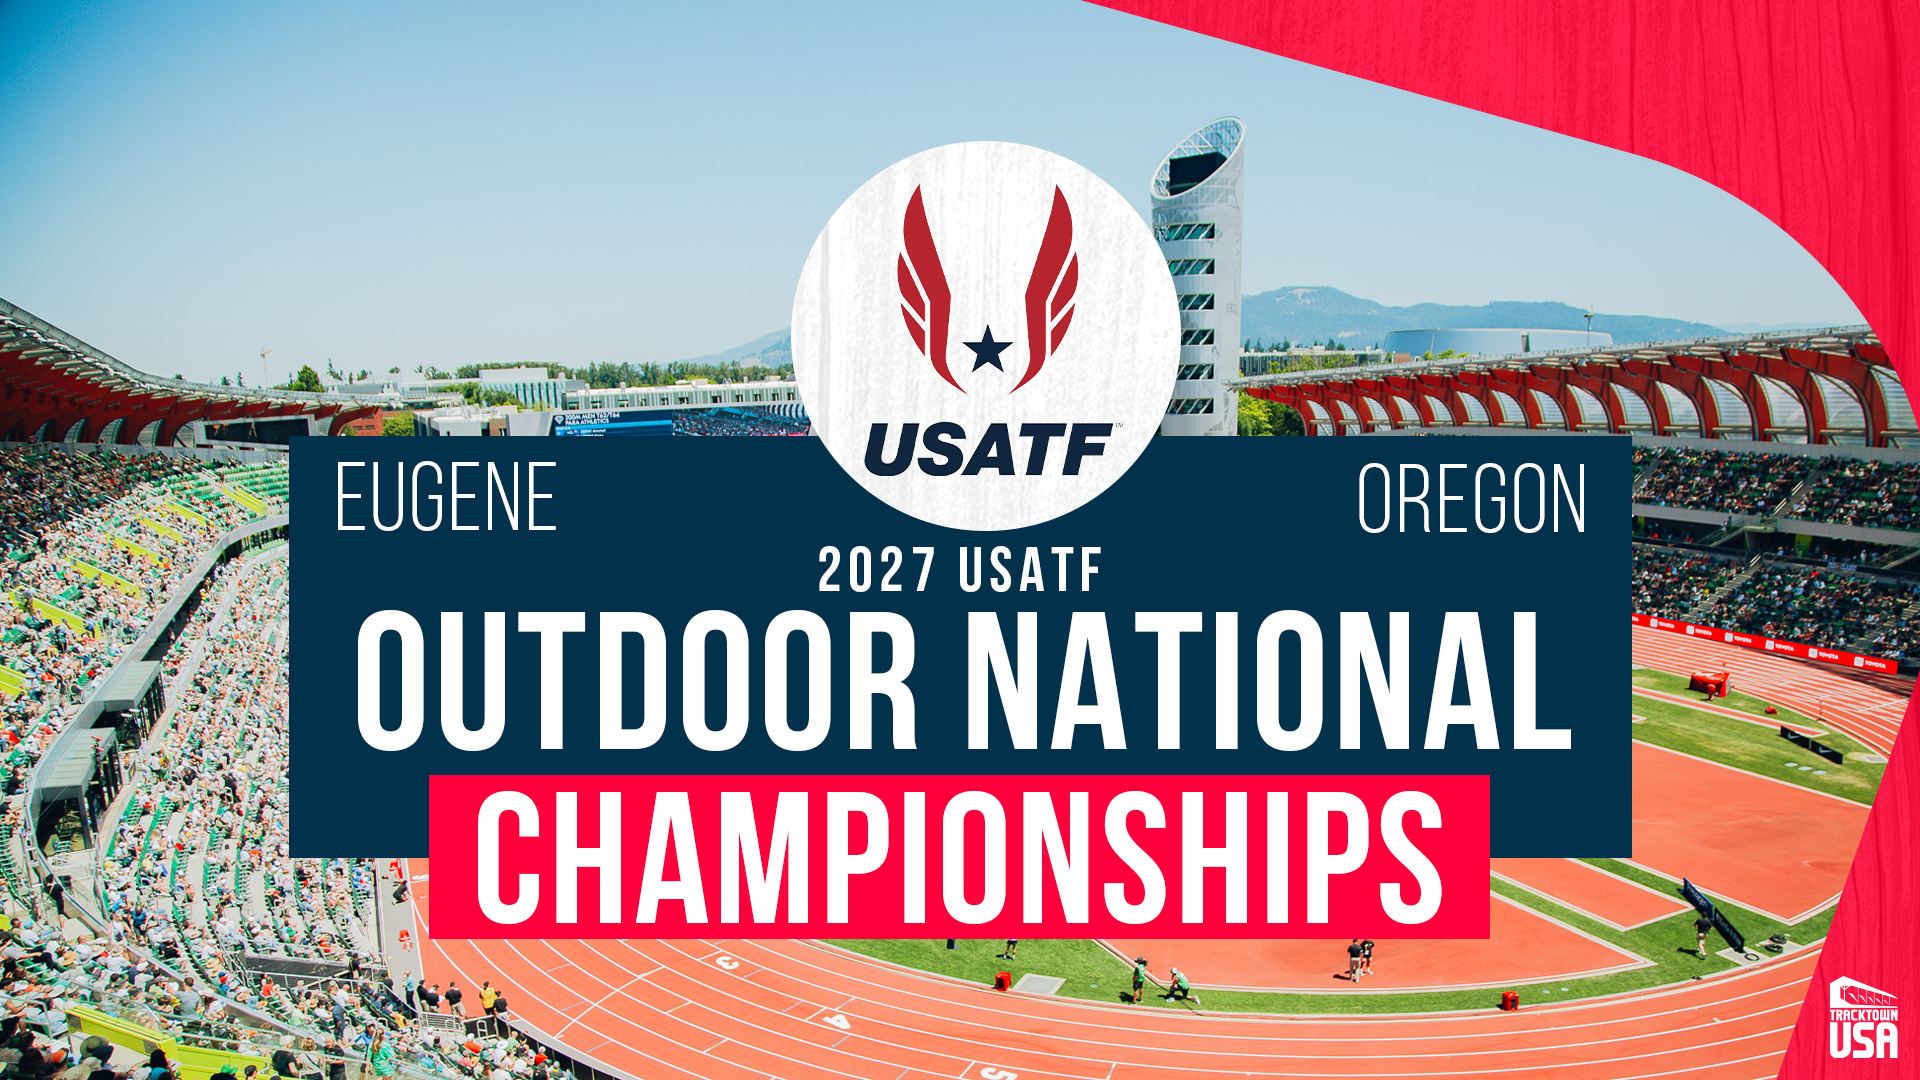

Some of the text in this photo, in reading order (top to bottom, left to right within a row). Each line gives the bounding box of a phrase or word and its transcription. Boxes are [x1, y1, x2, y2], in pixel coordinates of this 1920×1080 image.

[1695, 628, 1712, 636] TOYOTA
[1734, 635, 1752, 643] TOYOTA
[1775, 643, 1794, 651] TOYOTA
[1819, 651, 1839, 660] TOYOTA
[1864, 660, 1886, 669] TOYOTA
[715, 955, 740, 970] 3
[822, 1013, 851, 1030] 4
